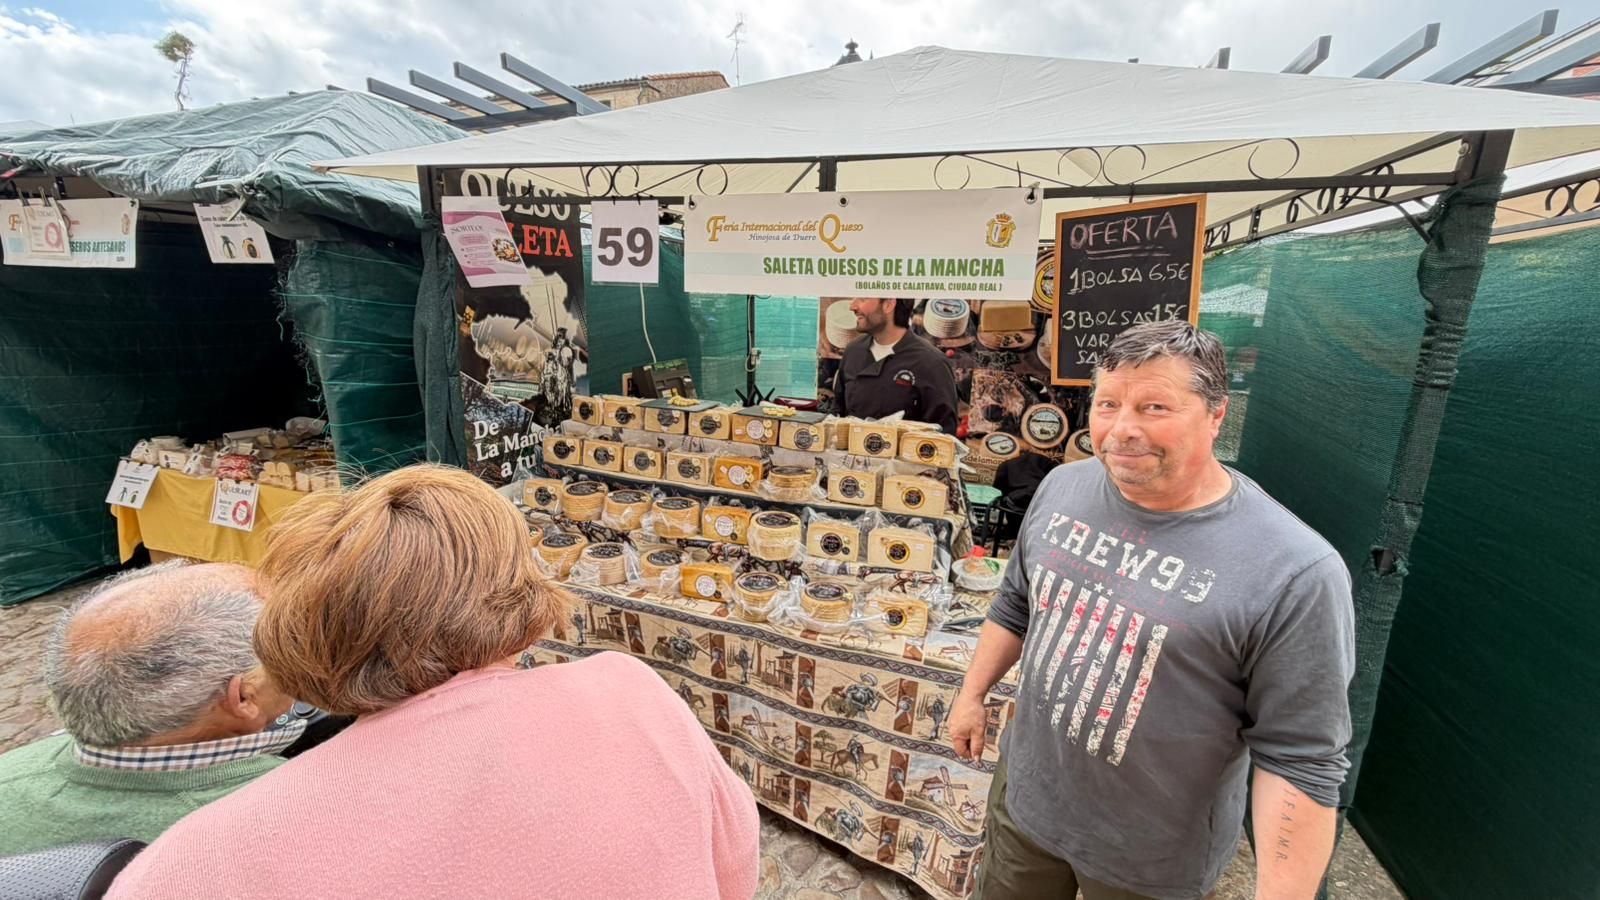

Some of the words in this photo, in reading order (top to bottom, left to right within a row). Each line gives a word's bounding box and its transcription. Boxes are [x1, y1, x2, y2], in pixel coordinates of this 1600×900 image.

[706, 215, 739, 242] Feria
[740, 221, 800, 232] Internacional
[802, 220, 819, 232] del
[818, 213, 864, 253] Queso
[748, 233, 781, 243] Hinojosa
[781, 233, 791, 241] de
[793, 233, 817, 241] Duero
[1070, 211, 1178, 249] OFERTA
[597, 227, 653, 268] 59
[763, 256, 814, 275] SALETA
[817, 257, 879, 277] QUESOS
[883, 258, 902, 276] DE
[906, 258, 926, 277] LA
[930, 258, 1005, 277] MANCHA
[1148, 262, 1190, 281] 6,5€
[892, 282, 901, 291] DE
[947, 282, 977, 291] CIUDAD
[978, 282, 997, 291] REAL
[473, 420, 499, 440] De
[475, 442, 500, 461] La
[500, 461, 513, 478] a
